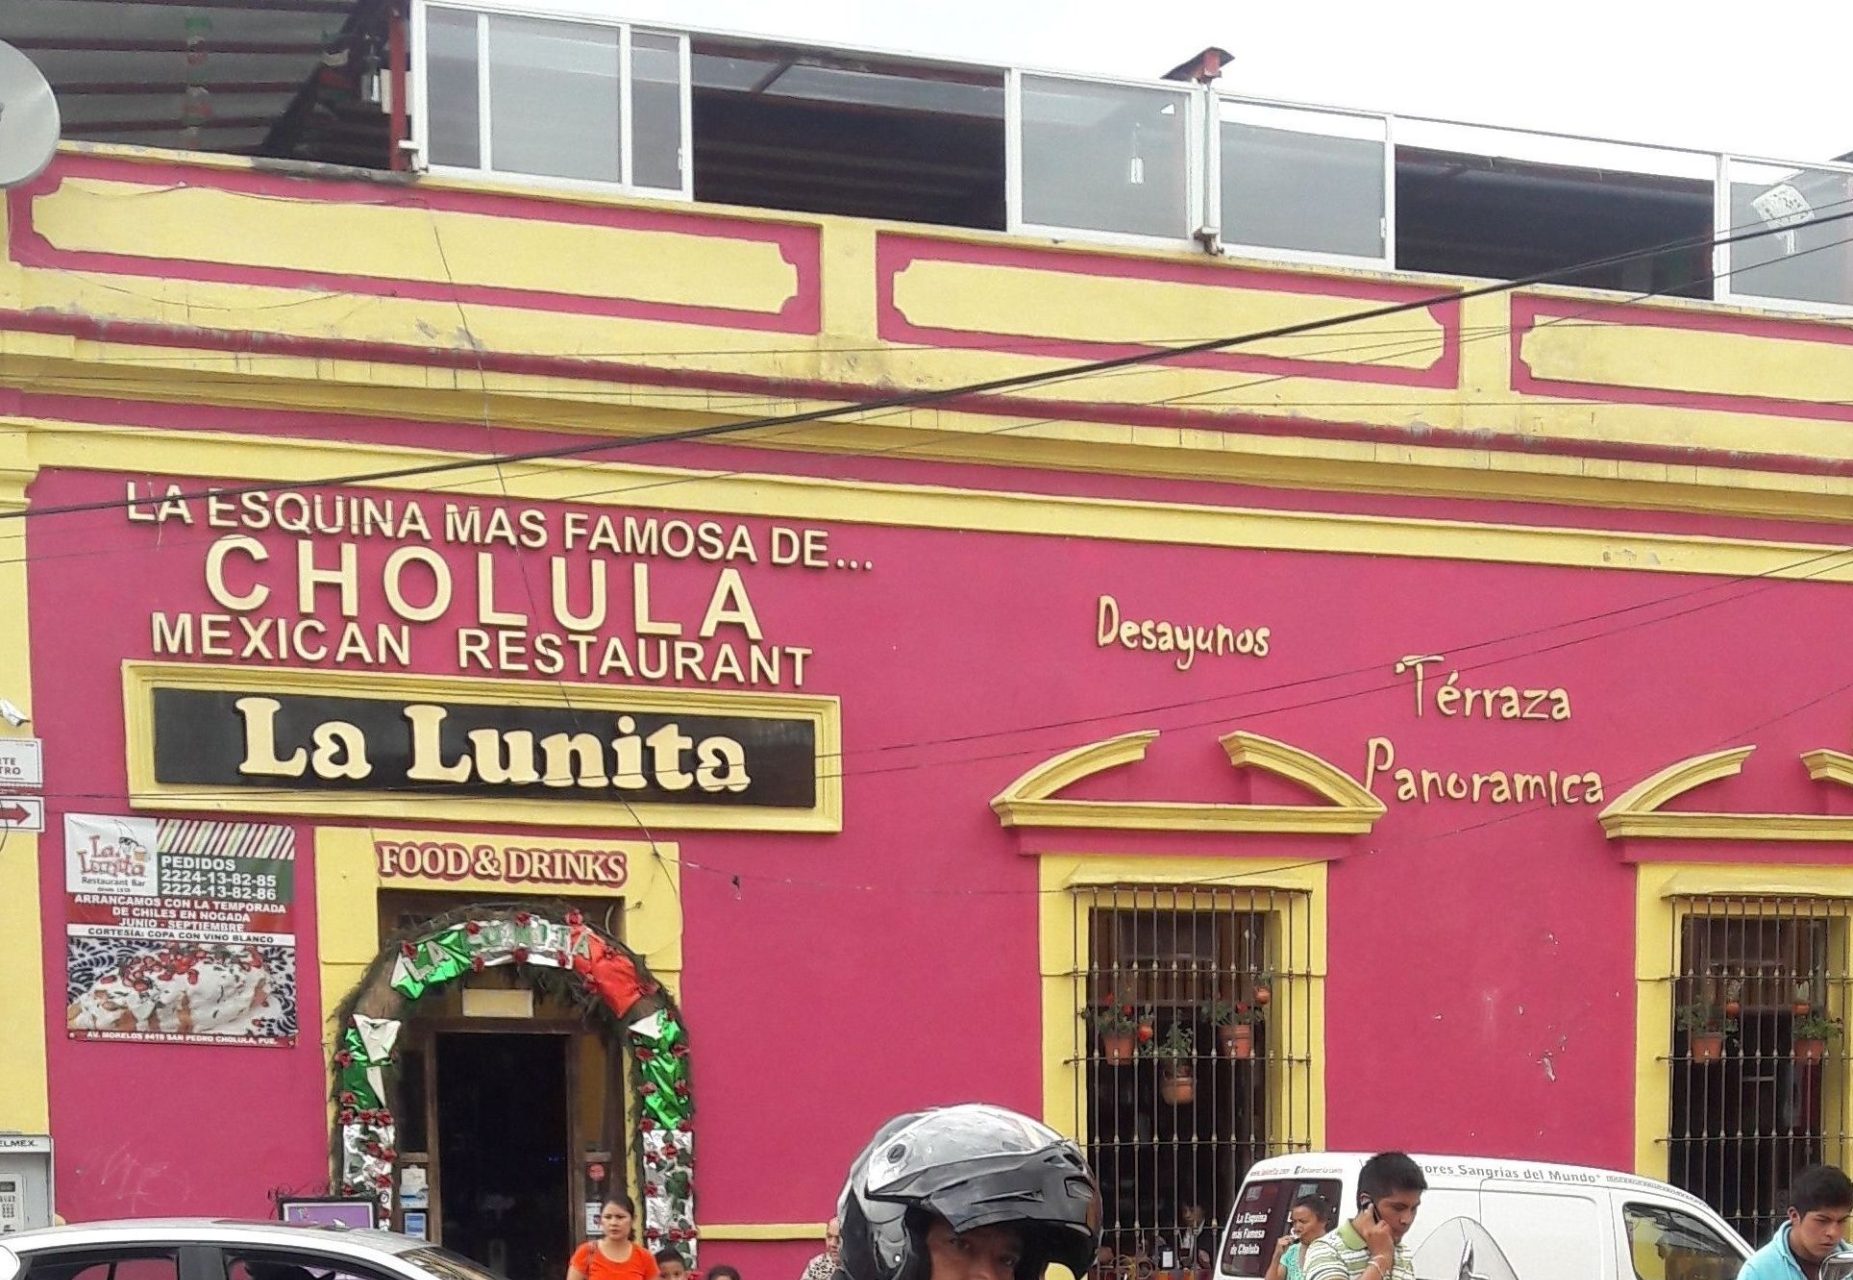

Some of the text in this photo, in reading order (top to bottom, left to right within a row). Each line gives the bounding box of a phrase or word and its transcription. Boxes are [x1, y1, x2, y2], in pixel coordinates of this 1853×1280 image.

[126, 481, 194, 524] LA
[208, 487, 432, 540] ESQUINA
[446, 503, 549, 549] MAS
[564, 512, 758, 563] FAMOSA
[205, 534, 763, 641] CHOLULA
[1098, 595, 1270, 671] Desayunos
[151, 611, 813, 687] MEXICAN RESTAURANT
[235, 697, 751, 793] La Lunita
[0, 757, 16, 765] TE
[1365, 737, 1604, 805] Panoramica
[161, 855, 236, 871] PEDIDOS
[380, 844, 626, 883] FOOD & DRINKS
[161, 868, 276, 887] 2224-13-82-85
[161, 883, 276, 900] 2224-13-82-86
[74, 894, 286, 914] ARRANCAMOS CON LA TEMPORADA
[112, 906, 250, 922] DE CHILES EN NOGADA
[119, 918, 157, 928] JUNIO
[168, 920, 244, 932] SEPTIEMBRE
[148, 930, 175, 938] COPA
[179, 931, 200, 940] CON
[203, 933, 229, 941] VINO
[232, 934, 274, 943] BLANCO
[1524, 1168, 1544, 1180] del
